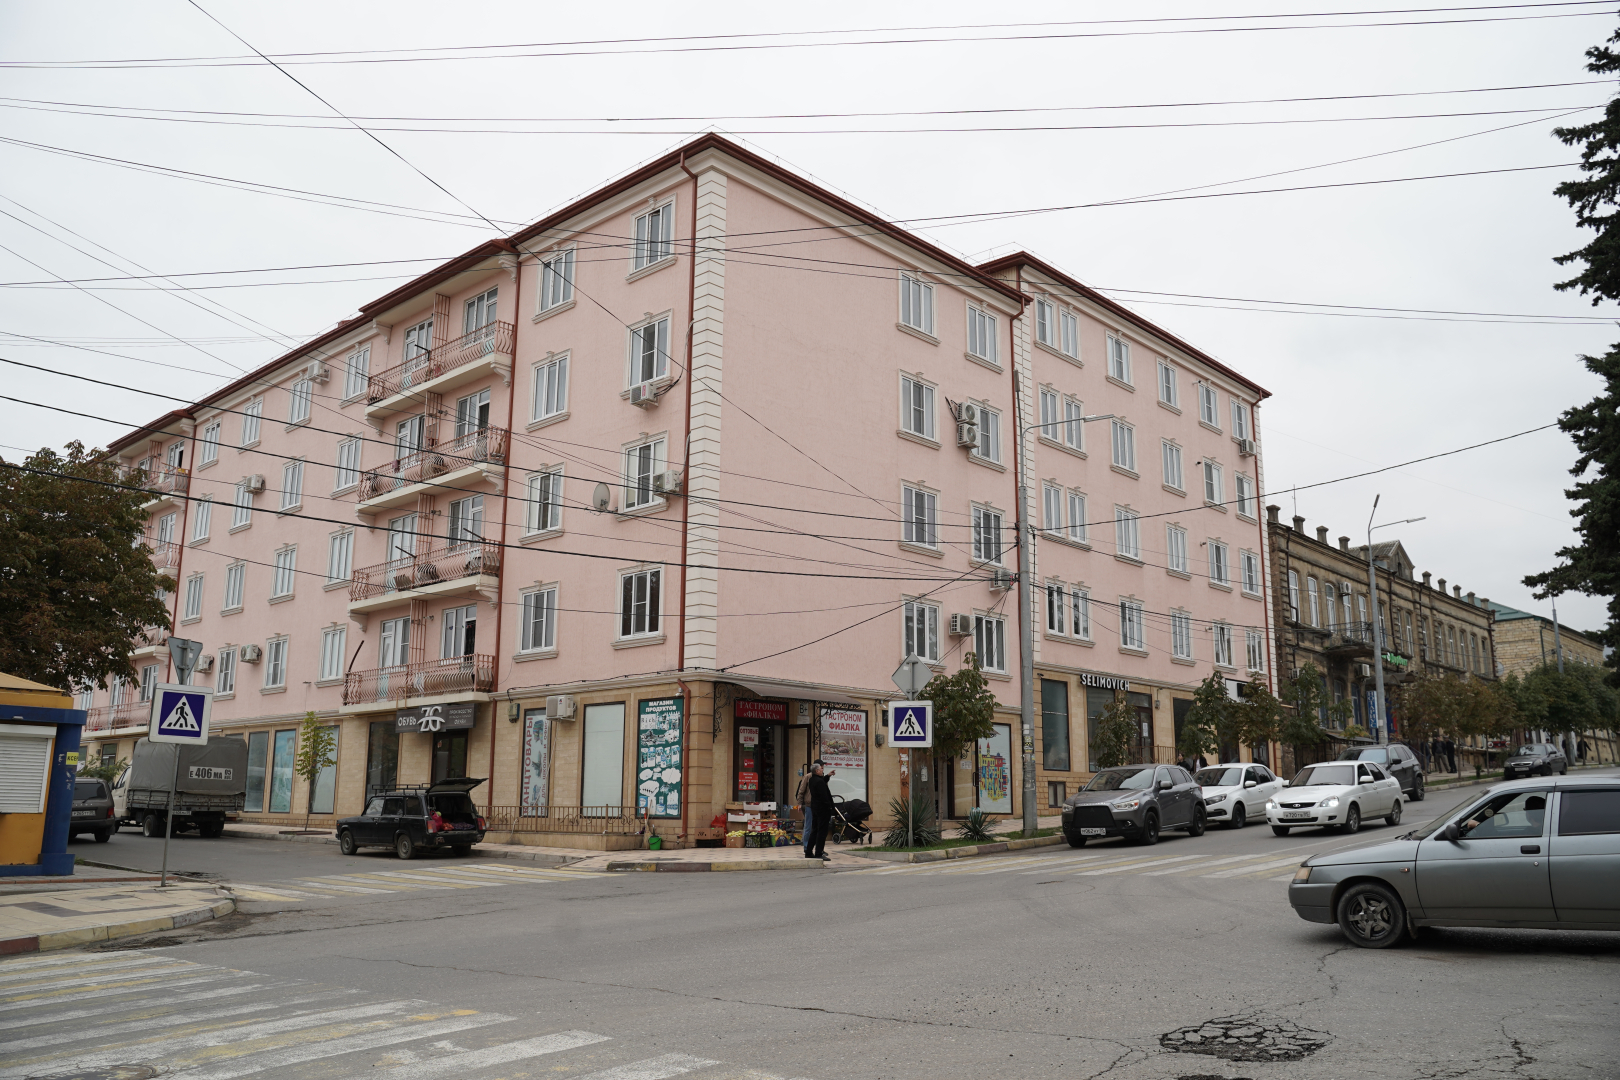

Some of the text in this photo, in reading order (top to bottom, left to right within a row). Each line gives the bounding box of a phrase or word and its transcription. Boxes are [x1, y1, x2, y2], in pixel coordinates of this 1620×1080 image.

[1081, 673, 1130, 691] SELIMOVICH
[740, 701, 783, 712] ГАСТРОНОМ
[398, 716, 417, 727] ОБУВЬ
[825, 712, 862, 722] ГАСТРОНОМ
[829, 722, 860, 731] ФИАЛКА
[195, 768, 213, 779] 406
[213, 771, 223, 779] МА
